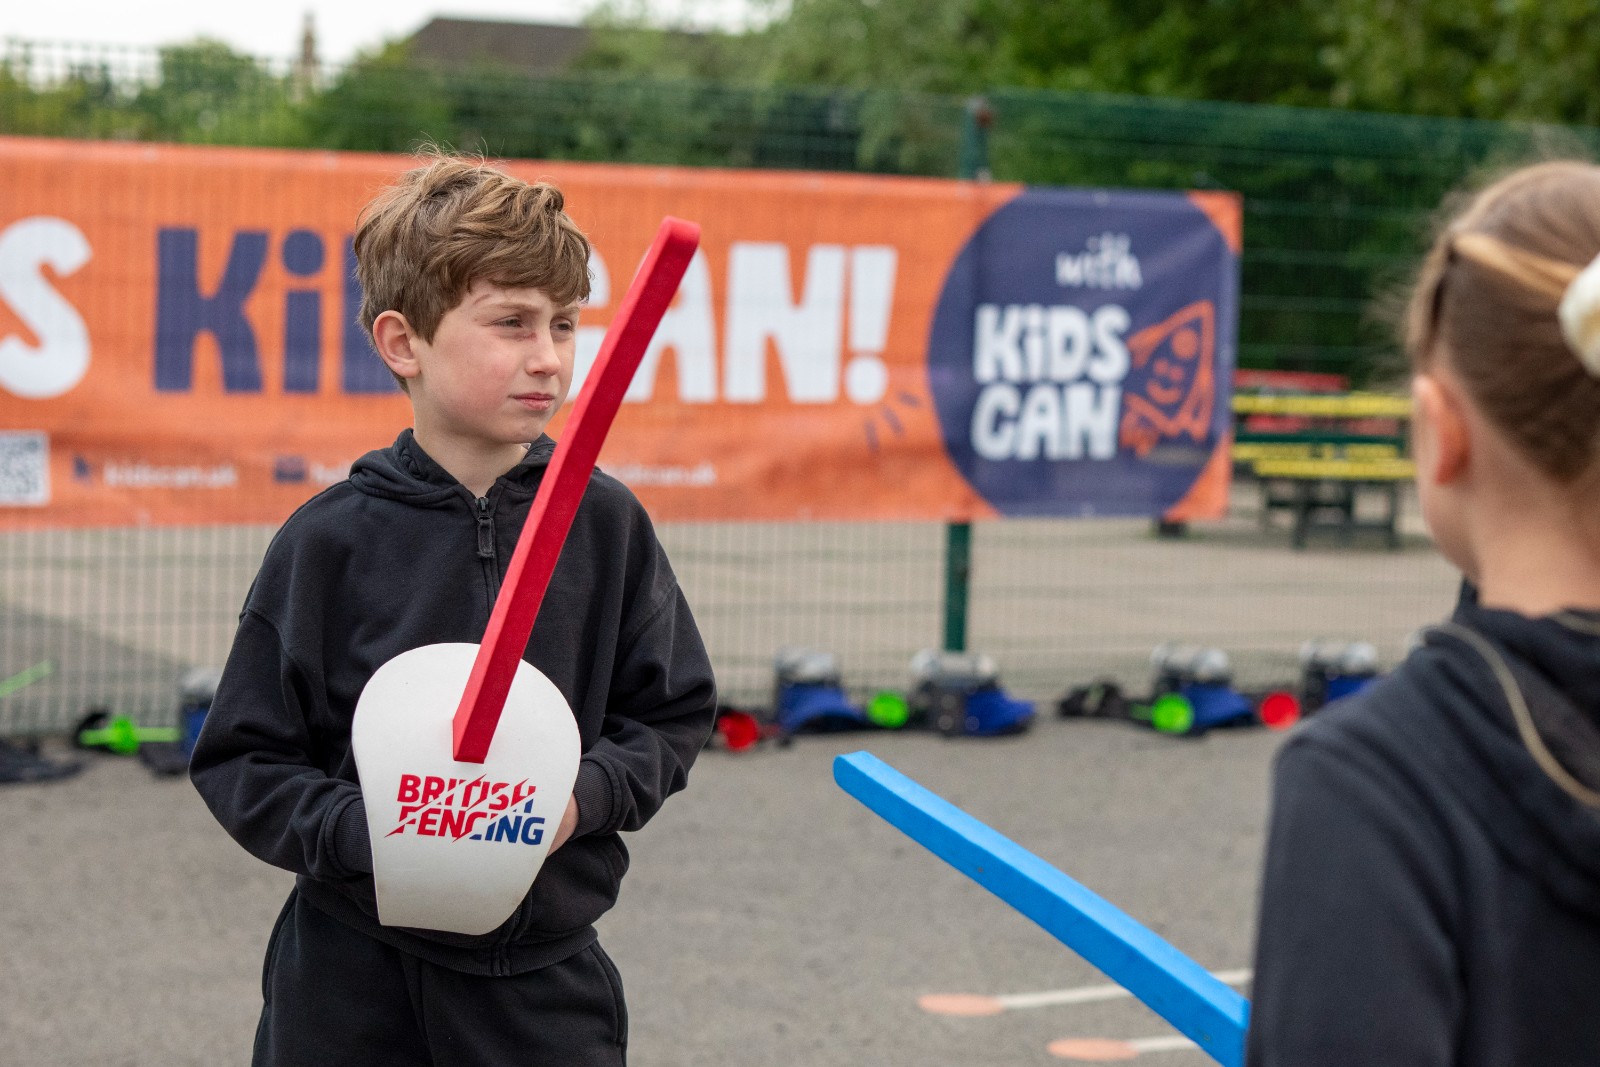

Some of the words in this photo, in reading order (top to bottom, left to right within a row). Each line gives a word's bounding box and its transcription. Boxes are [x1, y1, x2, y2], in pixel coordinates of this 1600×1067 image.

[970, 382, 1123, 461] CAN
[396, 773, 537, 814] BRITISH
[384, 805, 546, 846] FENCING
